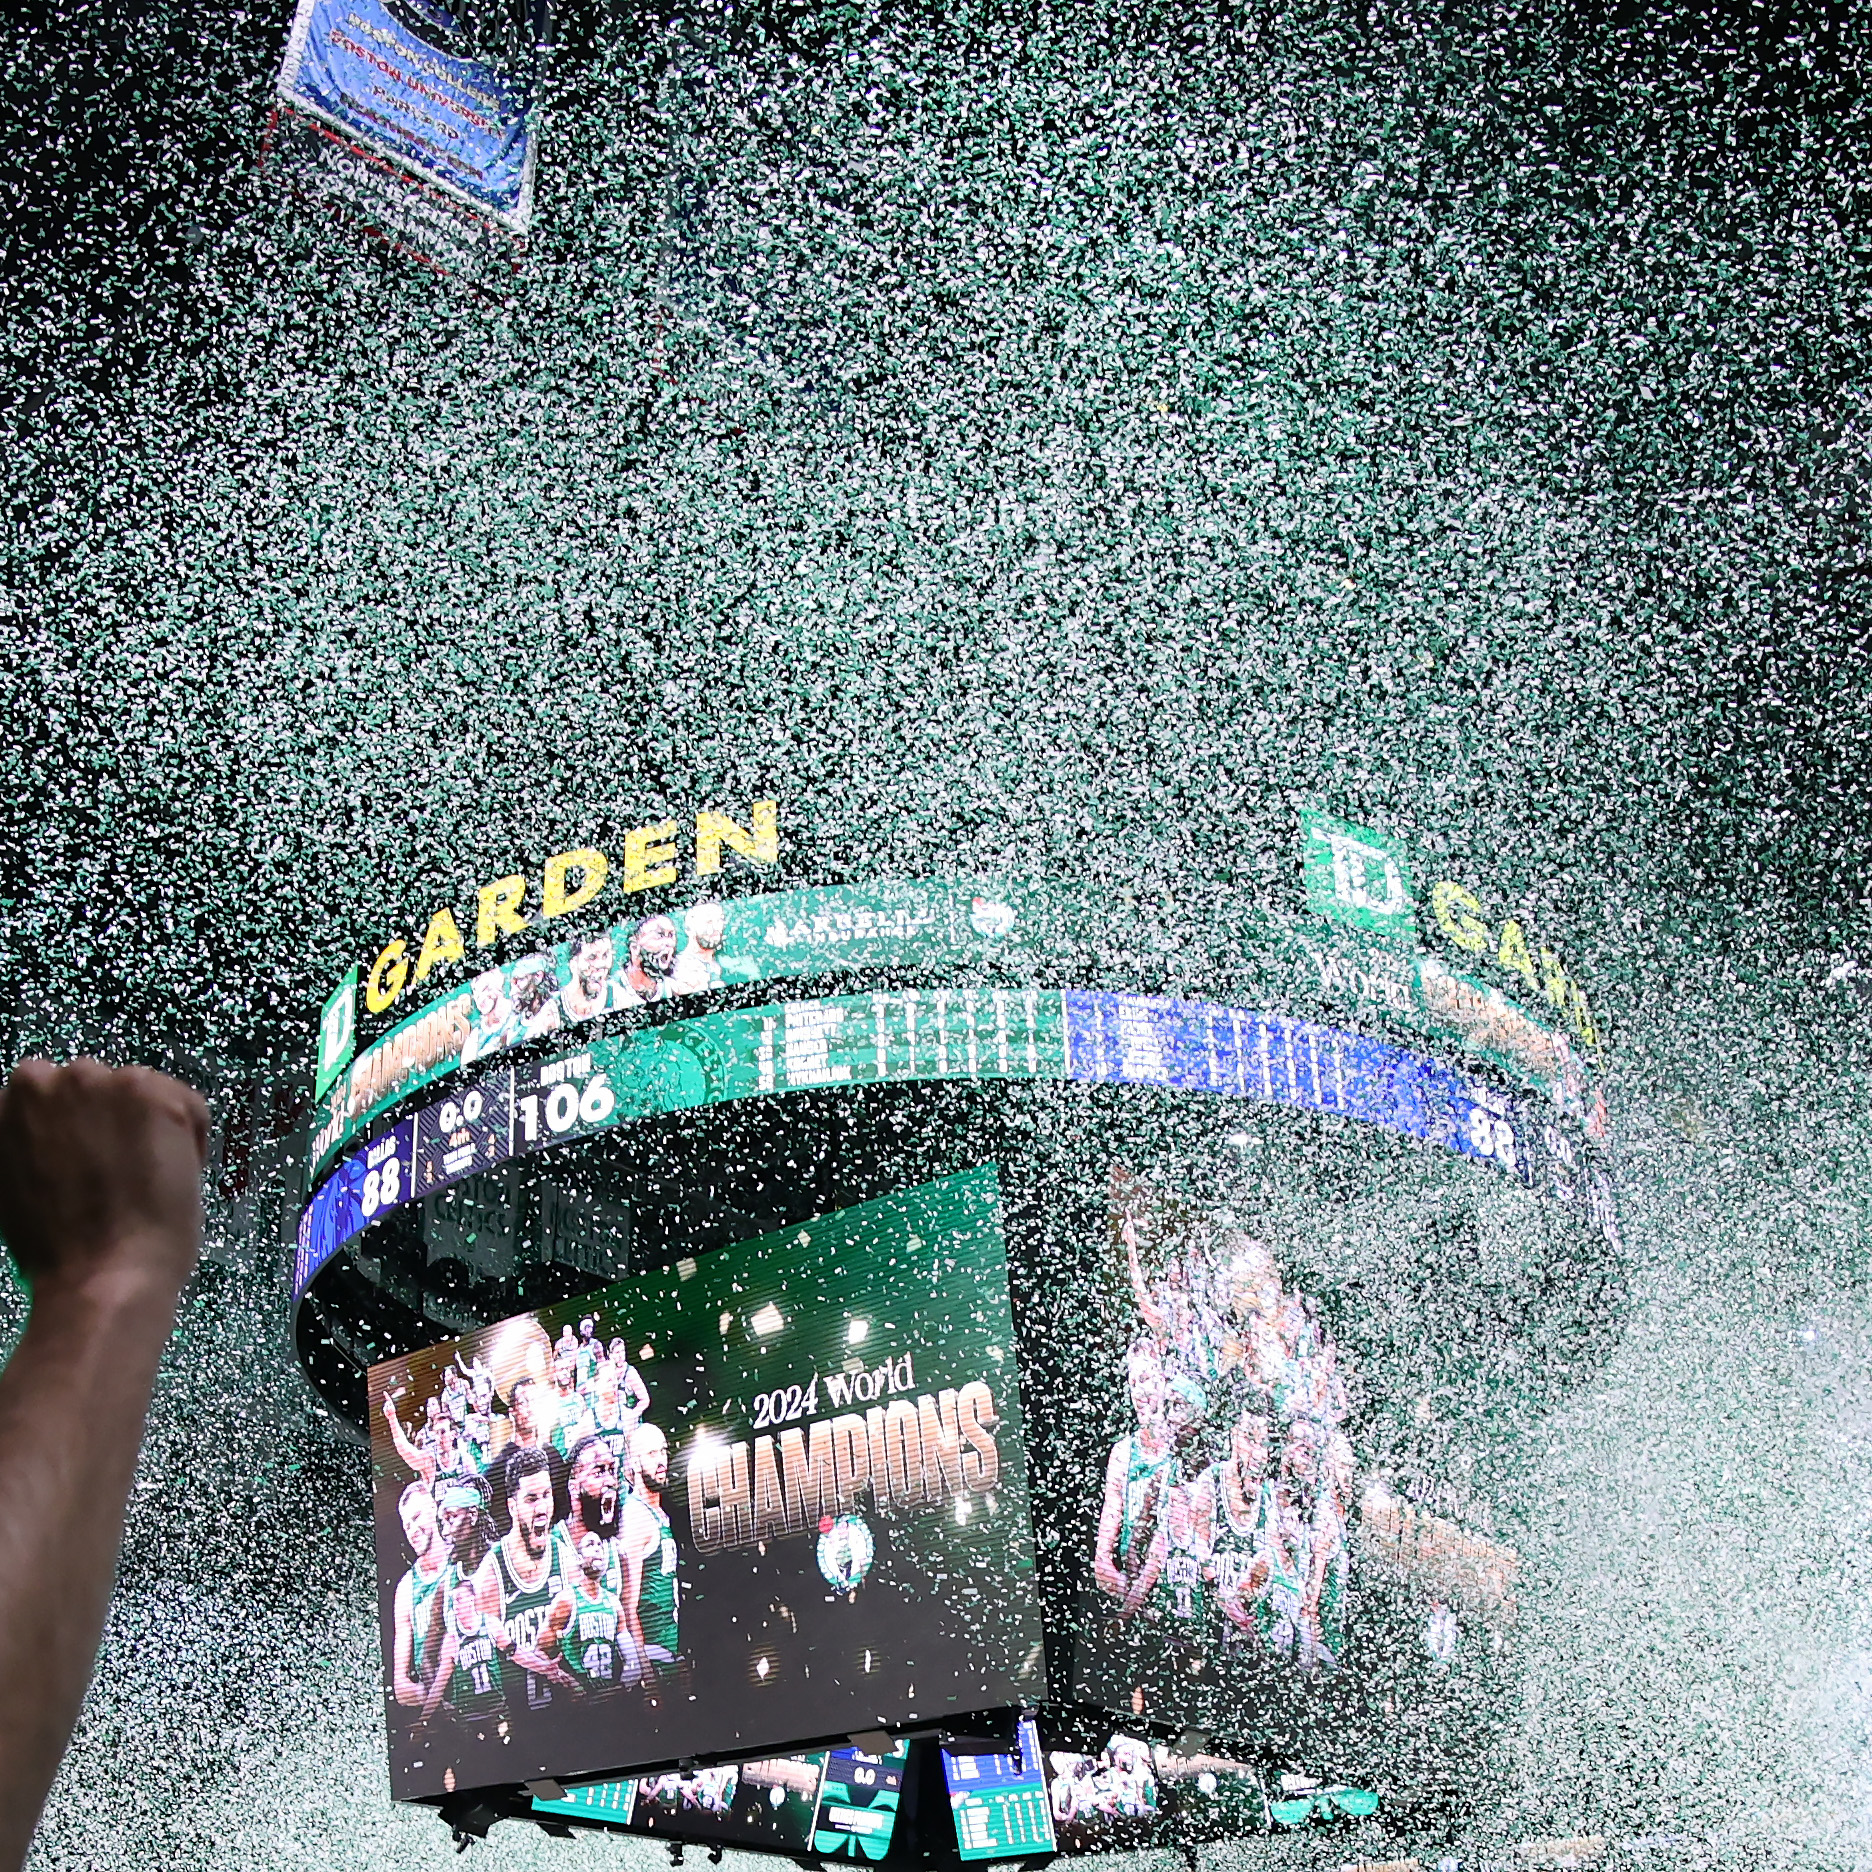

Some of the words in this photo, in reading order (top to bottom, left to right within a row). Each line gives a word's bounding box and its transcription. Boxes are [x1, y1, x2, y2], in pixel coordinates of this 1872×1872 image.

[365, 799, 778, 1015] GARDEN
[540, 1053, 592, 1086] BOSTON
[438, 1090, 483, 1133] 0.0
[520, 1073, 616, 1142] 106
[361, 1158, 400, 1217] 88
[753, 1389, 819, 1430] 2024
[824, 1352, 916, 1408] World
[687, 1380, 1002, 1556] CHAMPIONS
[505, 1606, 551, 1652] BOST
[579, 1611, 616, 1642] BOSTON
[581, 1642, 613, 1680] 42
[853, 1766, 876, 1786] 0.0
